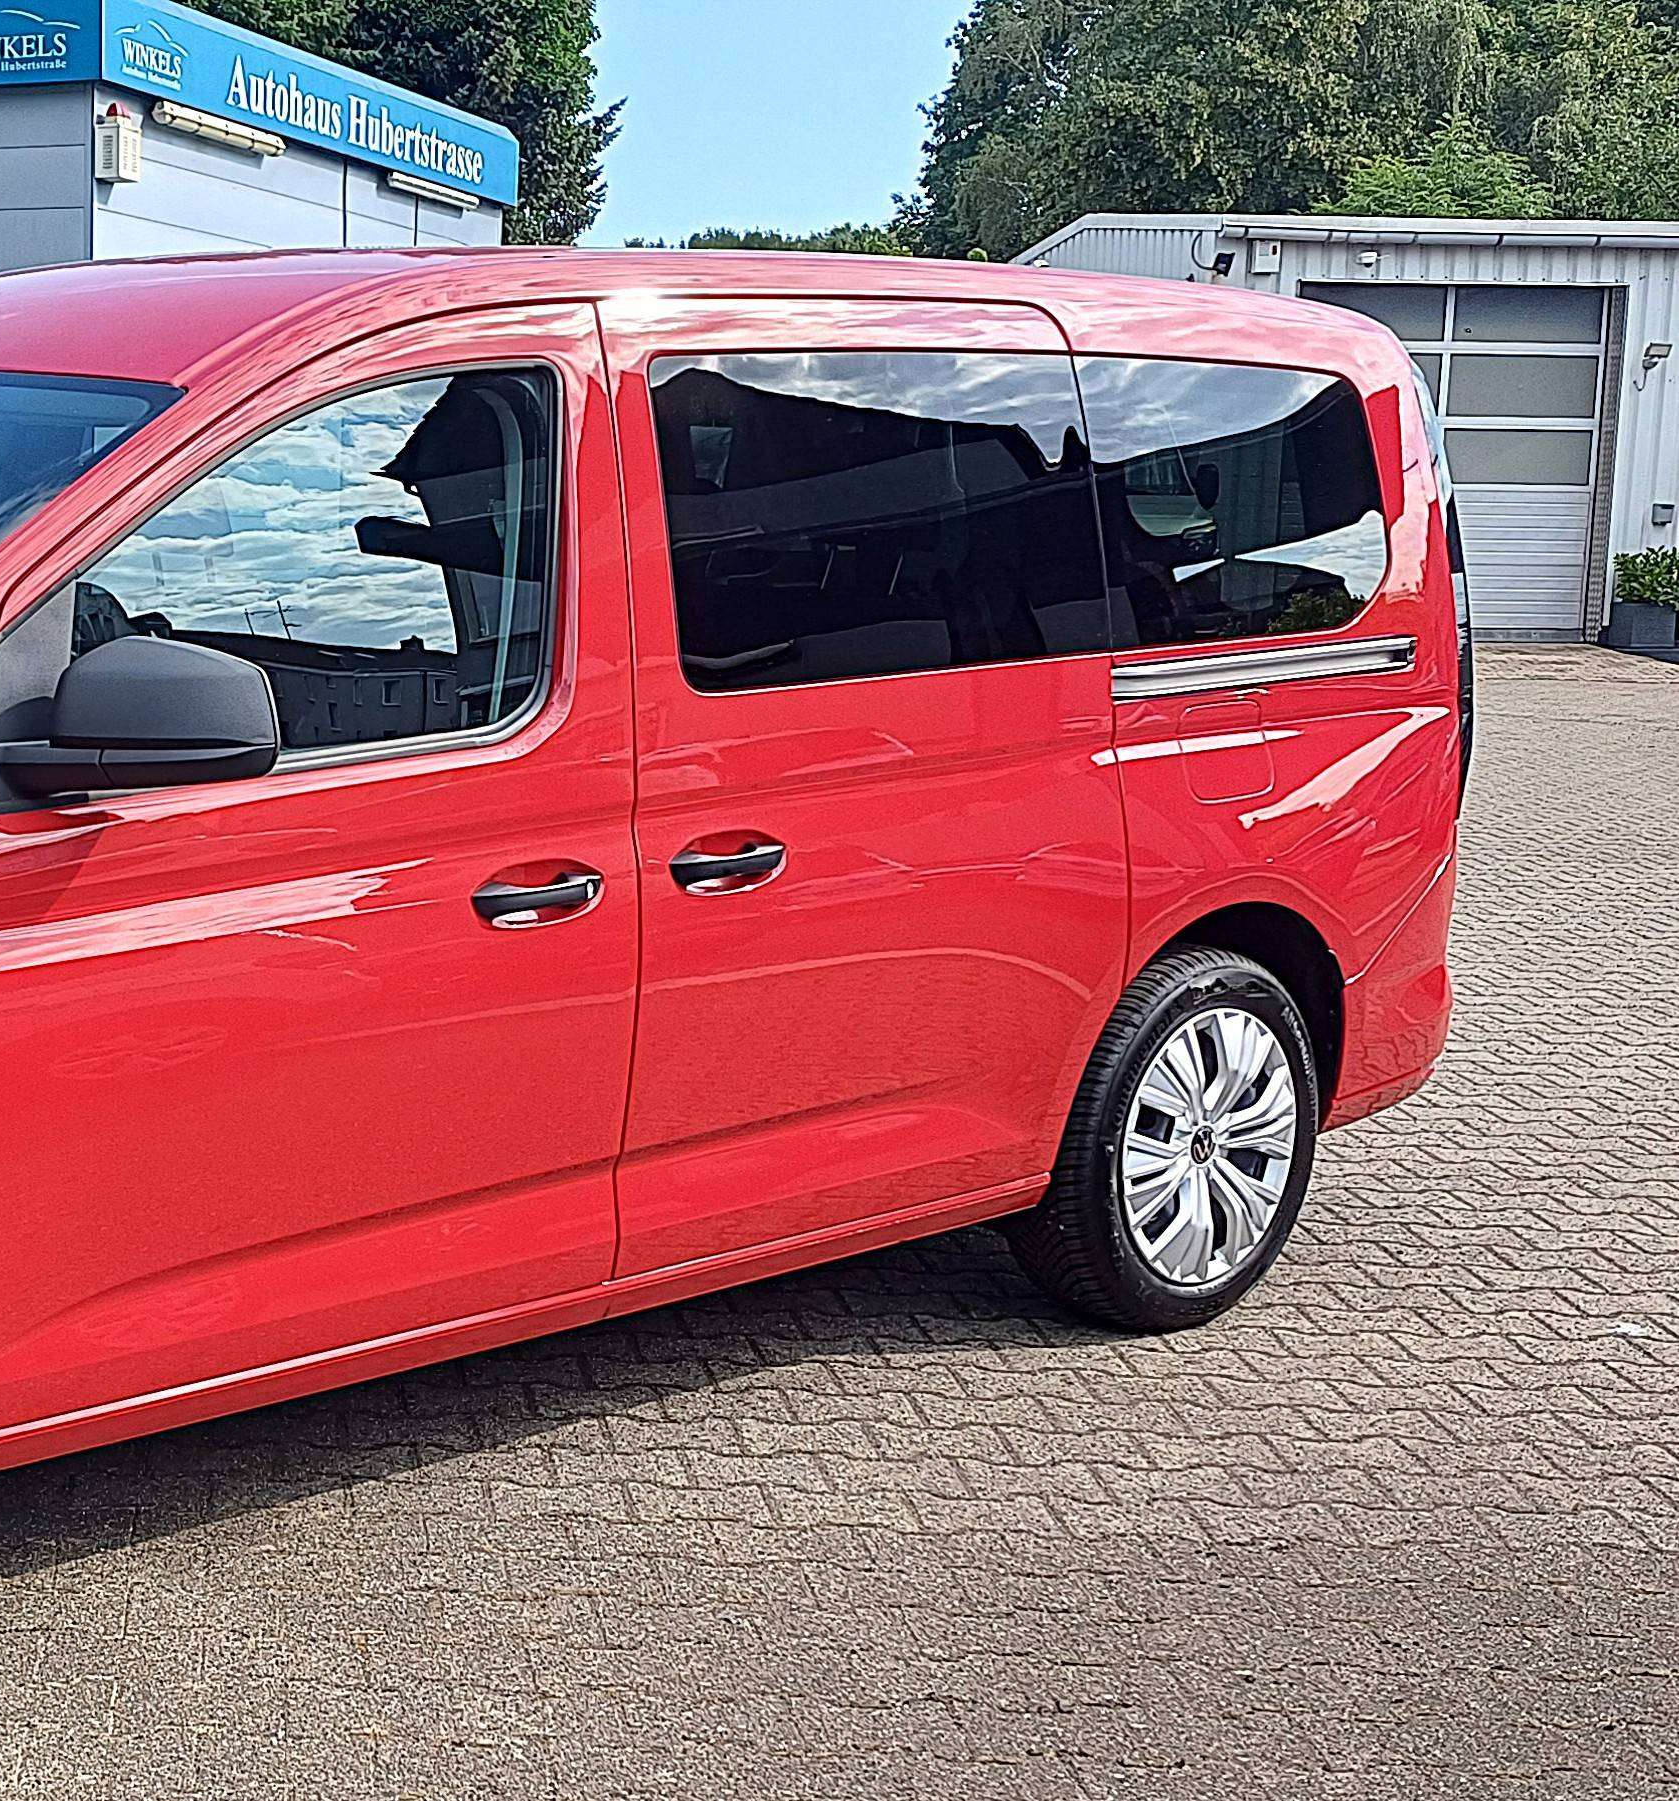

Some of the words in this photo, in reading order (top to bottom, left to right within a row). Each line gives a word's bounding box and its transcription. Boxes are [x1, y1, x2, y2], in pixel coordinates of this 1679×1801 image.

[121, 37, 182, 80] WINKELS
[225, 54, 343, 140] Autohaus
[347, 94, 484, 185] Hubertstrasse
